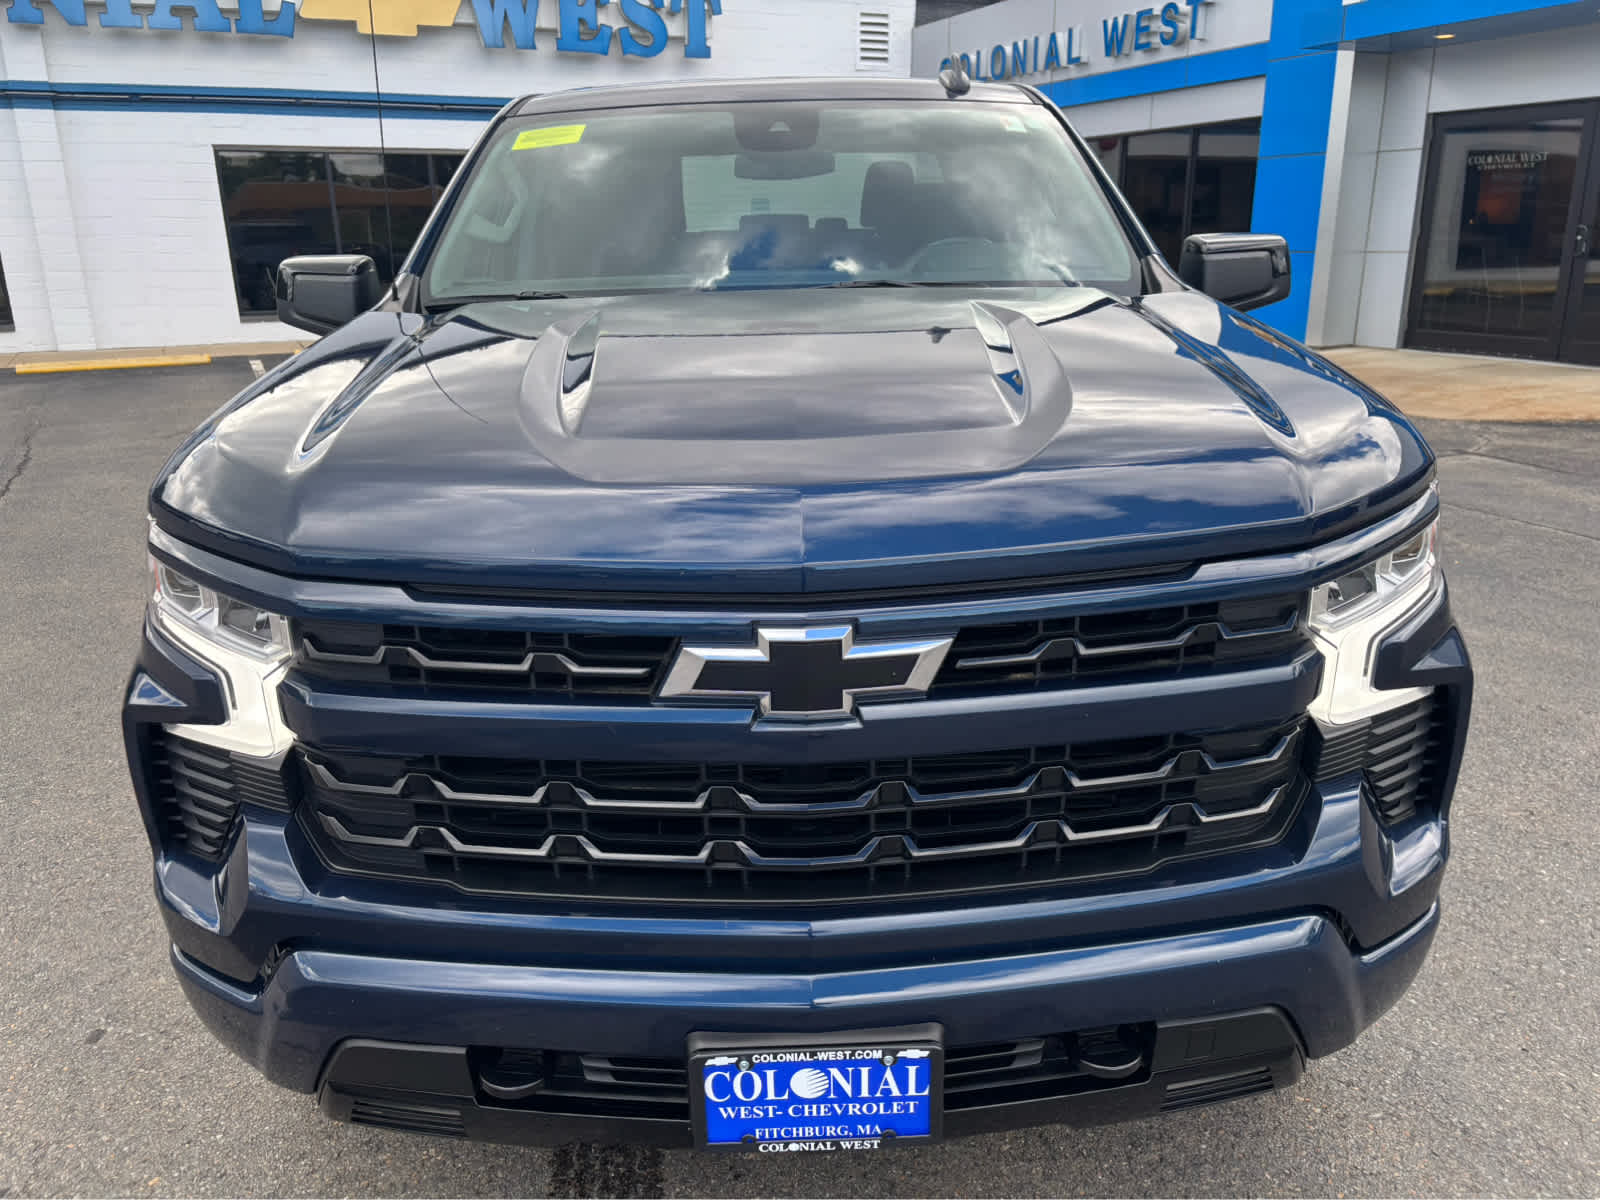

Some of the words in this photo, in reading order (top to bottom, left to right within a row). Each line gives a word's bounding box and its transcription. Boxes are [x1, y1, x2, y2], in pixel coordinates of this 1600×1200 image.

[472, 0, 722, 58] WEST
[1102, 0, 1206, 57] WEST
[1520, 151, 1550, 162] WEST
[752, 1049, 883, 1064] COLONIAL-WEST.COM
[704, 1065, 930, 1102] COLONIAL
[787, 1101, 919, 1117] CHEVROLET
[754, 1126, 853, 1139] FITCHBURG,
[857, 1124, 882, 1136] MA
[758, 1141, 836, 1153] COLONIAL
[840, 1139, 881, 1150] WEST
